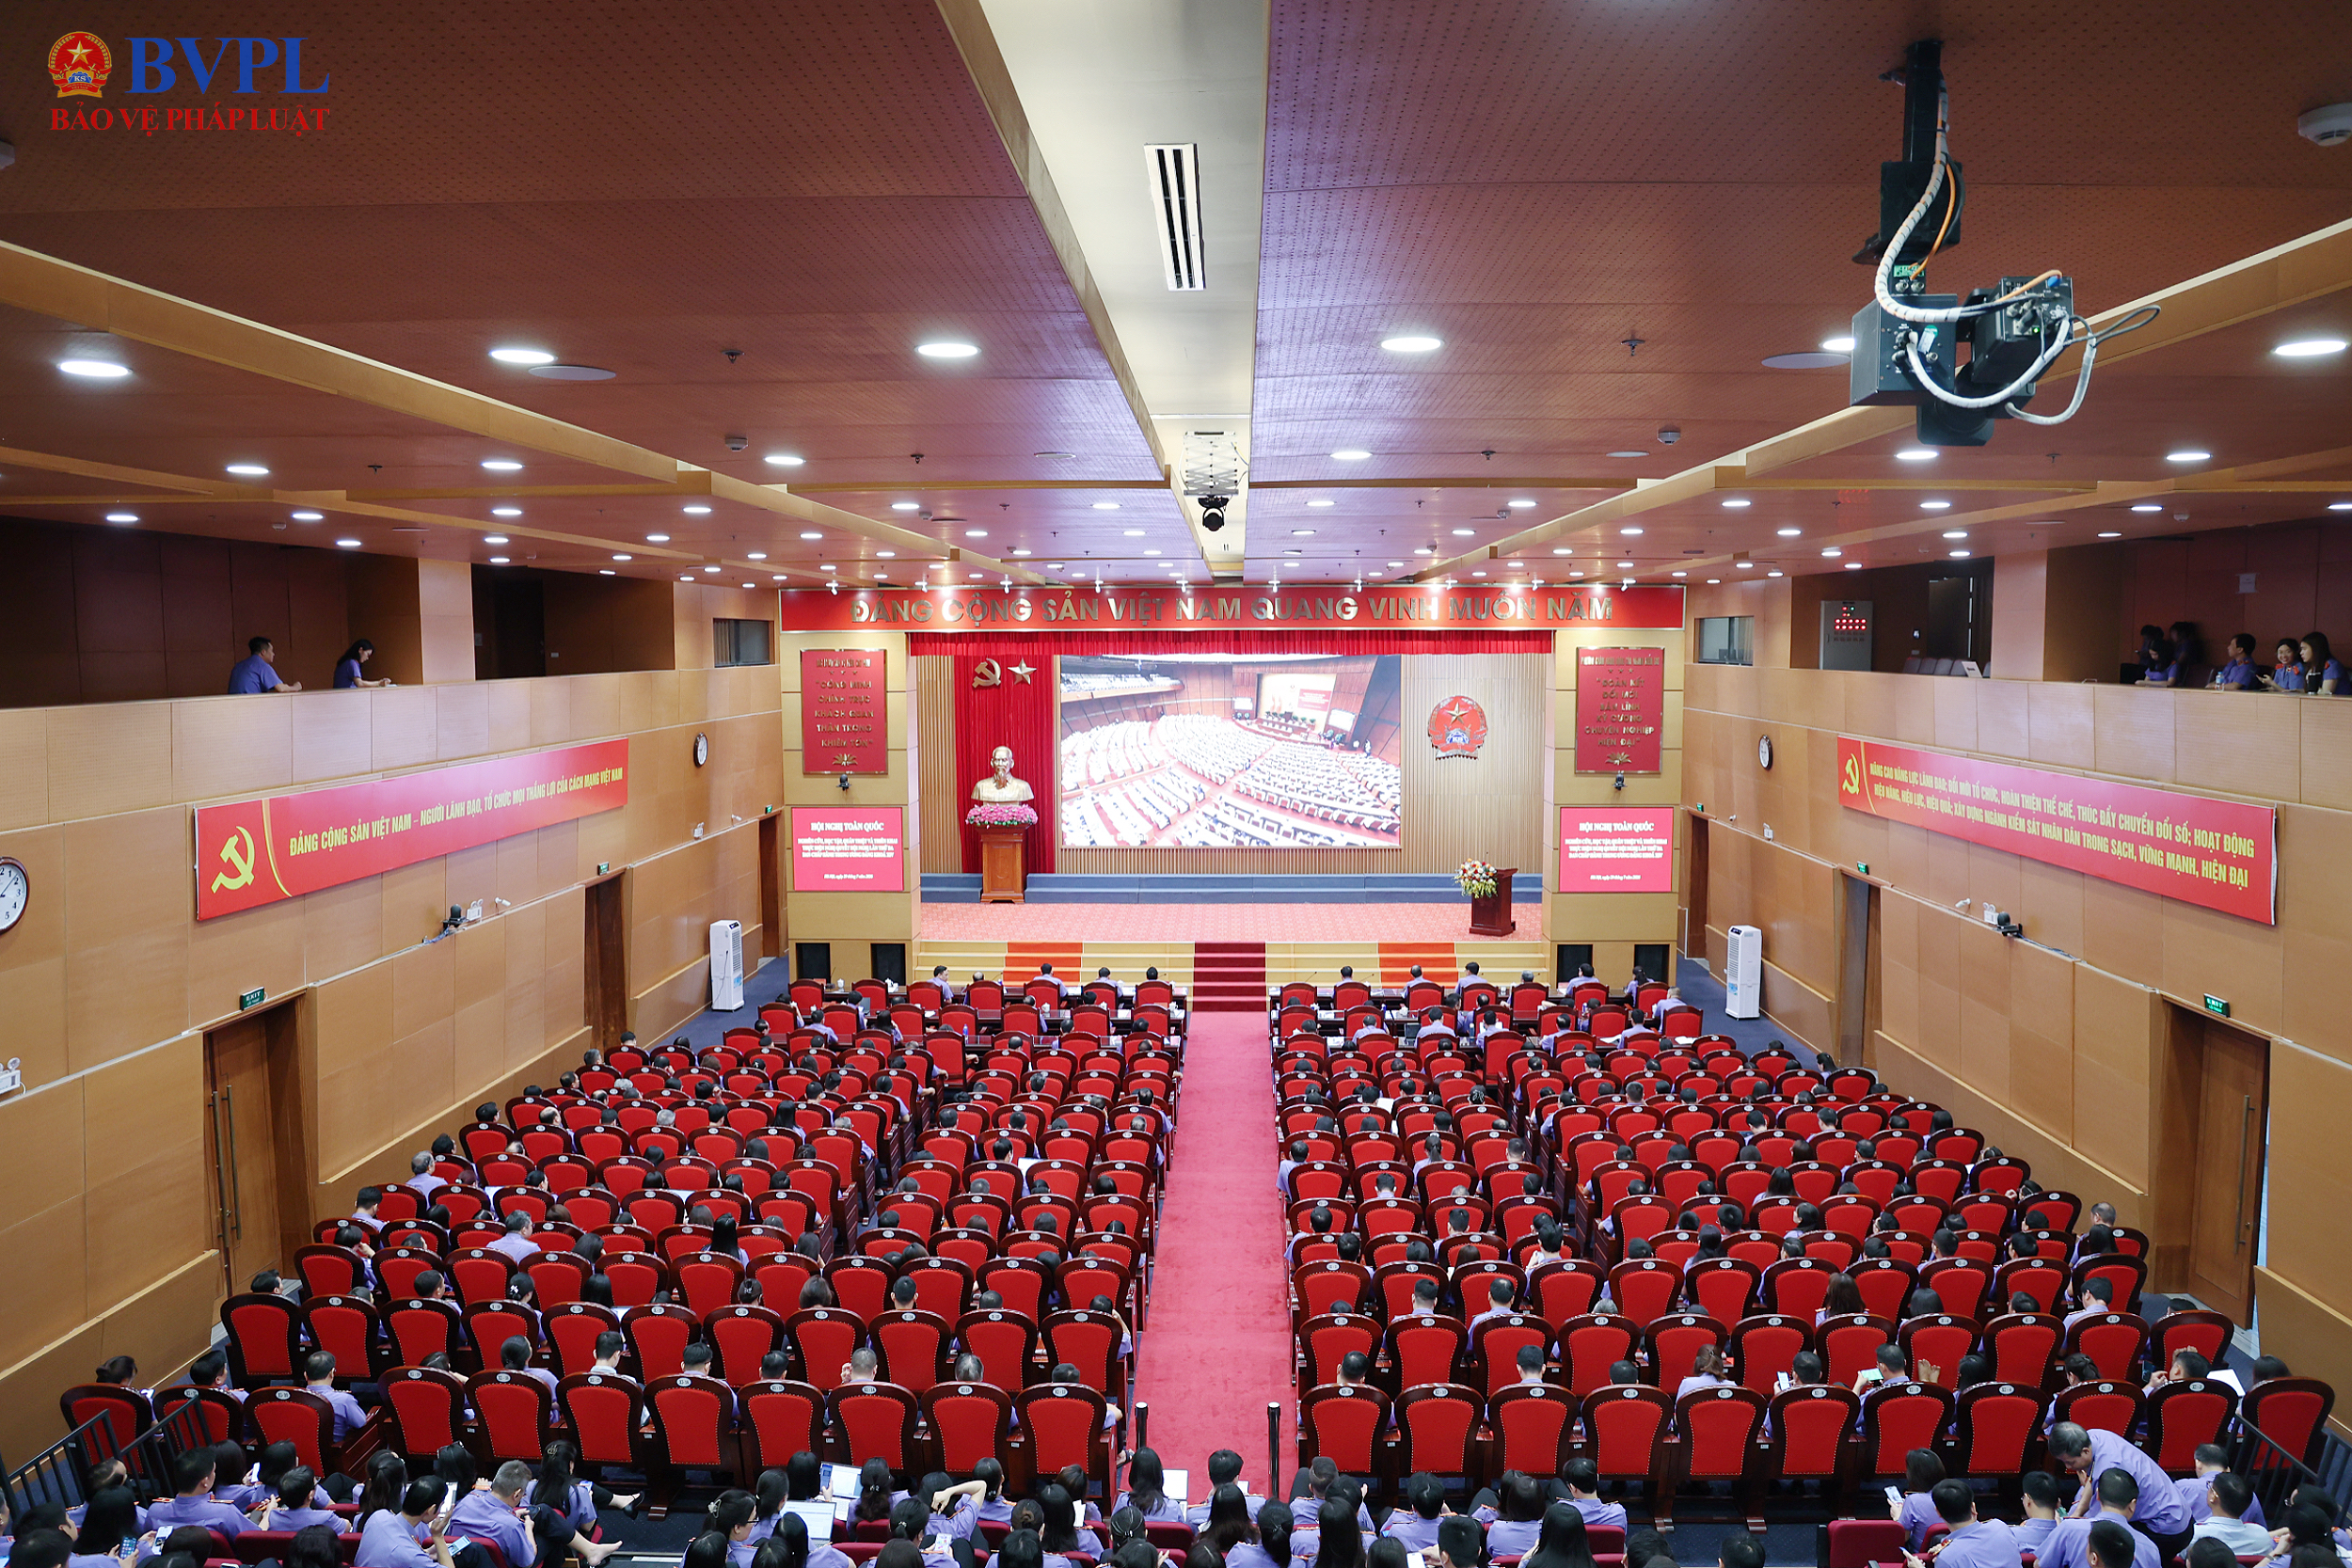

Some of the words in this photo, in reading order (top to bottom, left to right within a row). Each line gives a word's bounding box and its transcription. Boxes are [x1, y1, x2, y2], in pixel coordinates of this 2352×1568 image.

[850, 592, 933, 623] ĐẢNG
[942, 592, 1033, 627] CỘNG
[1042, 590, 1098, 621] SẢN
[1107, 591, 1166, 626] VIỆT
[1176, 598, 1241, 620] NAM
[1251, 597, 1359, 621] QUANG
[1368, 597, 1438, 620] VINH
[1449, 590, 1536, 620] MUÔN
[1548, 592, 1613, 620] NĂM
[289, 830, 318, 856] ĐẢNG
[321, 826, 348, 852] CỘNG
[350, 818, 370, 843] SẢN
[372, 816, 390, 839] VIỆT
[392, 813, 412, 833] NAM
[420, 803, 445, 826] NGƯỜI
[446, 800, 465, 820] LÃNH
[467, 798, 482, 817] ĐẠO,
[485, 790, 493, 811] TỔ
[494, 790, 511, 809] CHỨC
[513, 788, 525, 806] MỌI
[526, 780, 546, 801] THẮNG
[547, 781, 556, 799] LỢI
[557, 775, 568, 794] CỦA
[569, 775, 583, 792] CÁCH
[584, 772, 600, 790] MẠNG
[601, 768, 611, 786] VIỆT
[612, 767, 623, 782] NAM
[1884, 765, 1894, 779] CAO
[1909, 771, 1919, 787] LỰC
[1920, 771, 1934, 788] LÃNH
[1948, 776, 1958, 794] ĐỔI
[1959, 780, 1971, 797] MỚI
[1972, 780, 1980, 799] TỔ
[1981, 785, 2001, 805] CHỨC,
[2001, 789, 2020, 807] HOÀN
[2021, 793, 2042, 814] THIỆN
[2042, 794, 2057, 815] THỂ
[2058, 799, 2076, 821] CHẾ,
[2077, 804, 2098, 824] THÚC
[2100, 805, 2116, 828] ĐẨY
[2118, 812, 2154, 836] CHUYỂN
[2156, 816, 2172, 840] ĐỔI
[2175, 821, 2192, 847] SỐ;
[2194, 829, 2221, 853] HOẠT
[2224, 832, 2255, 858] ĐỘNG
[810, 822, 824, 832] HỘI
[825, 823, 843, 832] NGHỊ
[843, 821, 863, 831] TOÀN
[864, 821, 884, 832] QUỐC
[1580, 822, 1593, 832] HỘI
[1594, 823, 1612, 832] NGHỊ
[1613, 821, 1632, 831] TOÀN
[1633, 821, 1654, 832] QUỐC
[1954, 801, 1966, 817] XÂY
[1967, 805, 1984, 823] DỰNG
[1985, 809, 2007, 828] NGÀNH
[2008, 811, 2026, 832] KIỂM
[2027, 818, 2040, 836] SÁT
[2042, 822, 2063, 842] NHÂN
[2064, 826, 2081, 846] DÂN
[2082, 832, 2109, 853] TRONG
[2111, 839, 2137, 862] SẠCH,
[2139, 844, 2164, 867] VỮNG
[2166, 852, 2199, 878] MẠNH,
[2202, 859, 2226, 884] HIỆN
[2229, 866, 2248, 891] ĐẠI
[16, 888, 21, 897] 3
[246, 991, 261, 1001] EXIT
